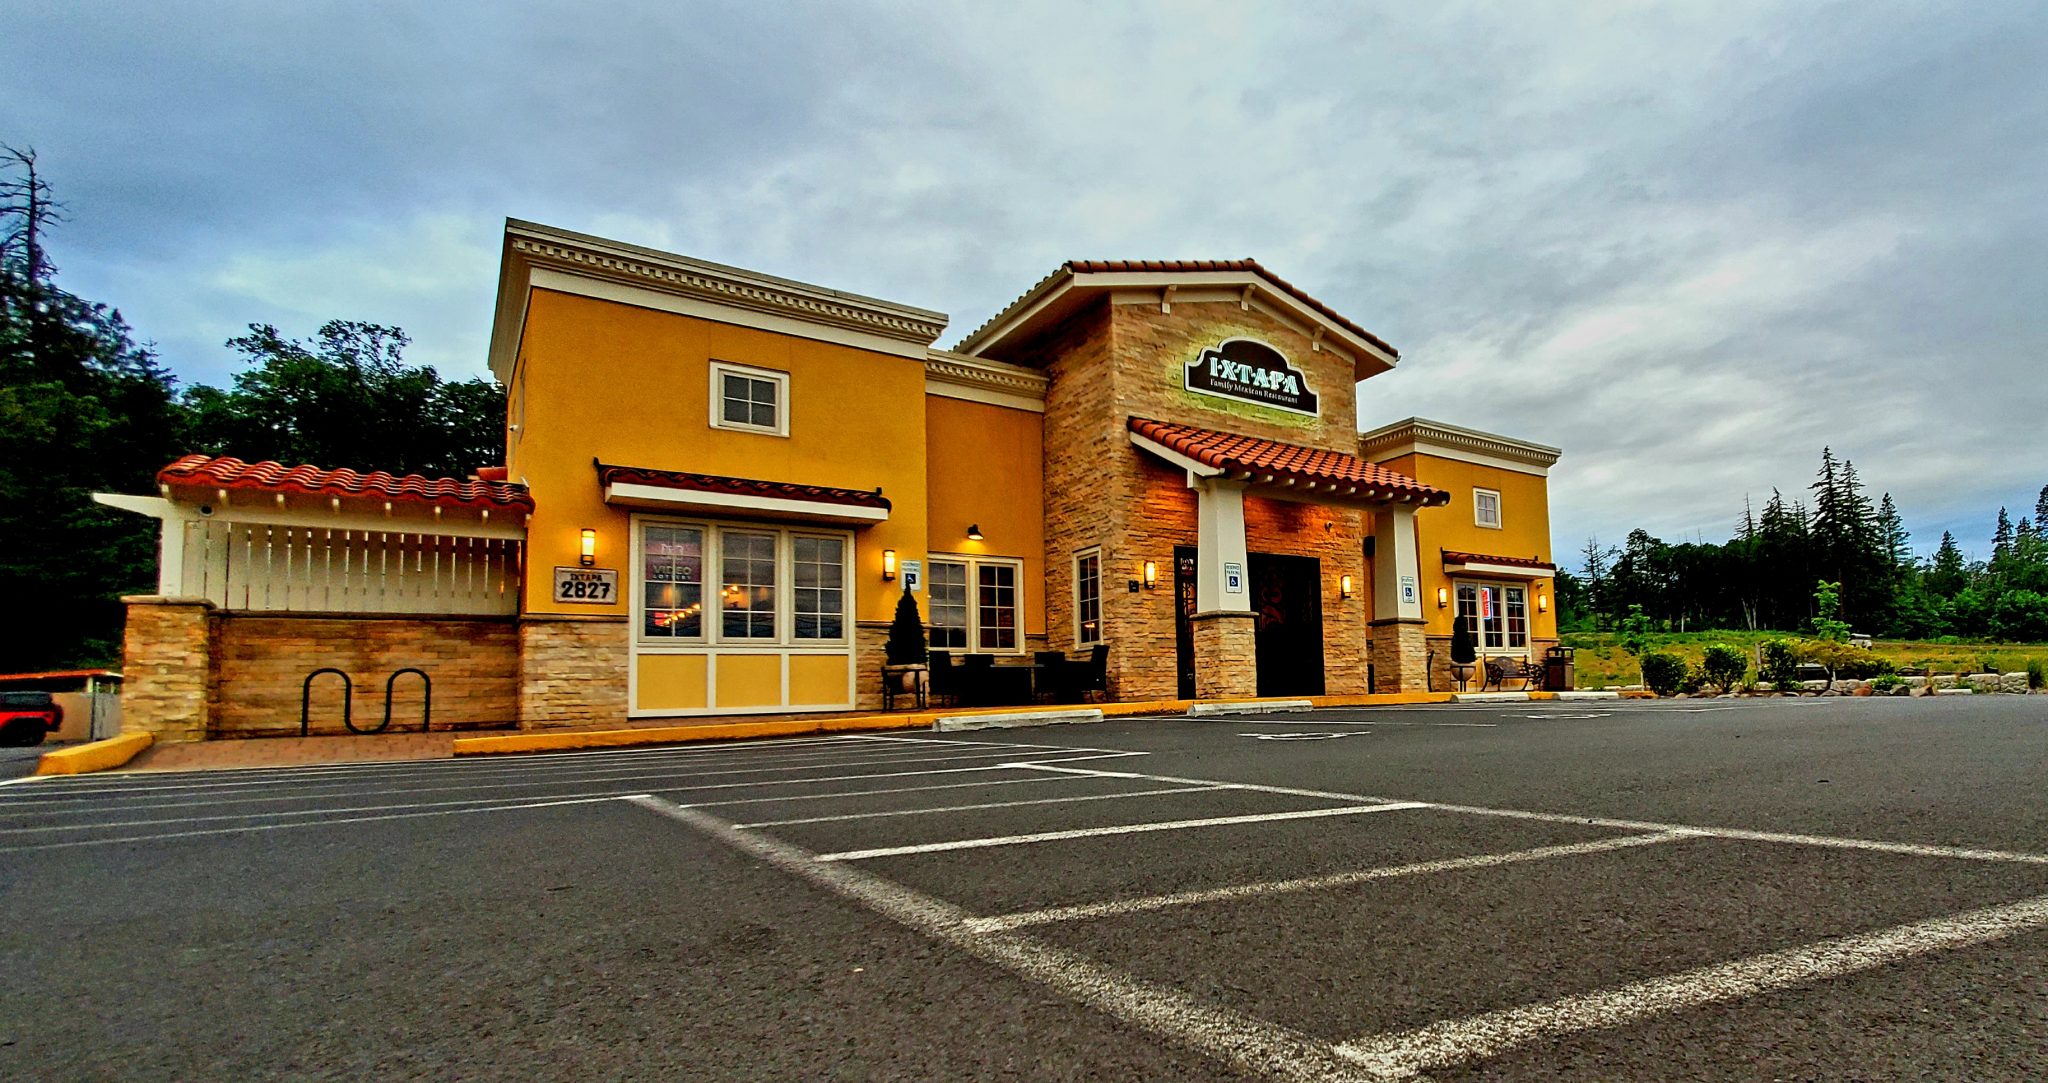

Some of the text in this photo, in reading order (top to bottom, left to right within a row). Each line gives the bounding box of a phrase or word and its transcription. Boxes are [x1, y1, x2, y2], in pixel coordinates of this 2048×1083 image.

[1210, 378, 1298, 404] Family Mexican Restaurant
[653, 565, 692, 575] VIDEO
[570, 573, 603, 582] IXTAPA
[561, 581, 611, 599] 2827
